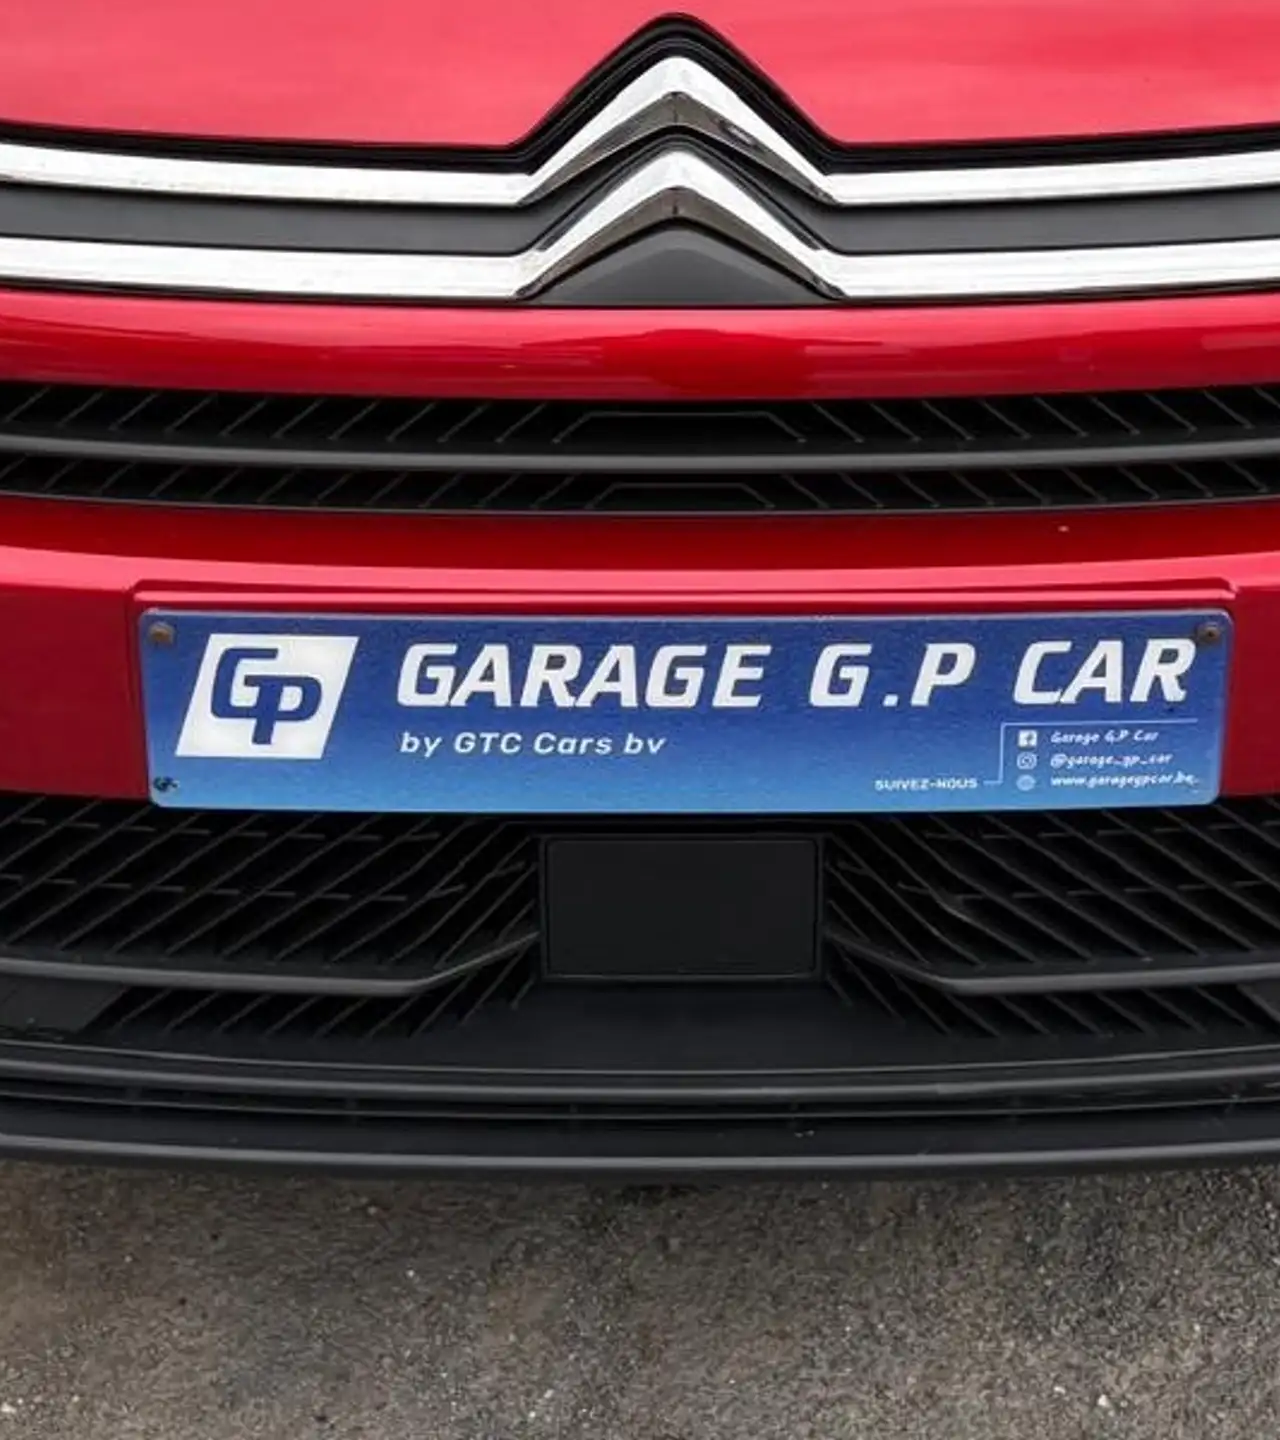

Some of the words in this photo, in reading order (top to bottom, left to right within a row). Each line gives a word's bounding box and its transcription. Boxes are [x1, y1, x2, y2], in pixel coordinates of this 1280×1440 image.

[397, 643, 772, 709] GARAGE
[809, 642, 975, 708] G.P
[1013, 638, 1196, 706] CAR
[400, 731, 440, 757] by
[454, 732, 522, 755] GTC
[534, 732, 612, 755] Cars
[624, 731, 666, 754] bv
[1050, 730, 1100, 745] Garage
[1134, 729, 1159, 742] Car
[874, 777, 978, 791] SUIVEZ-NOUS
